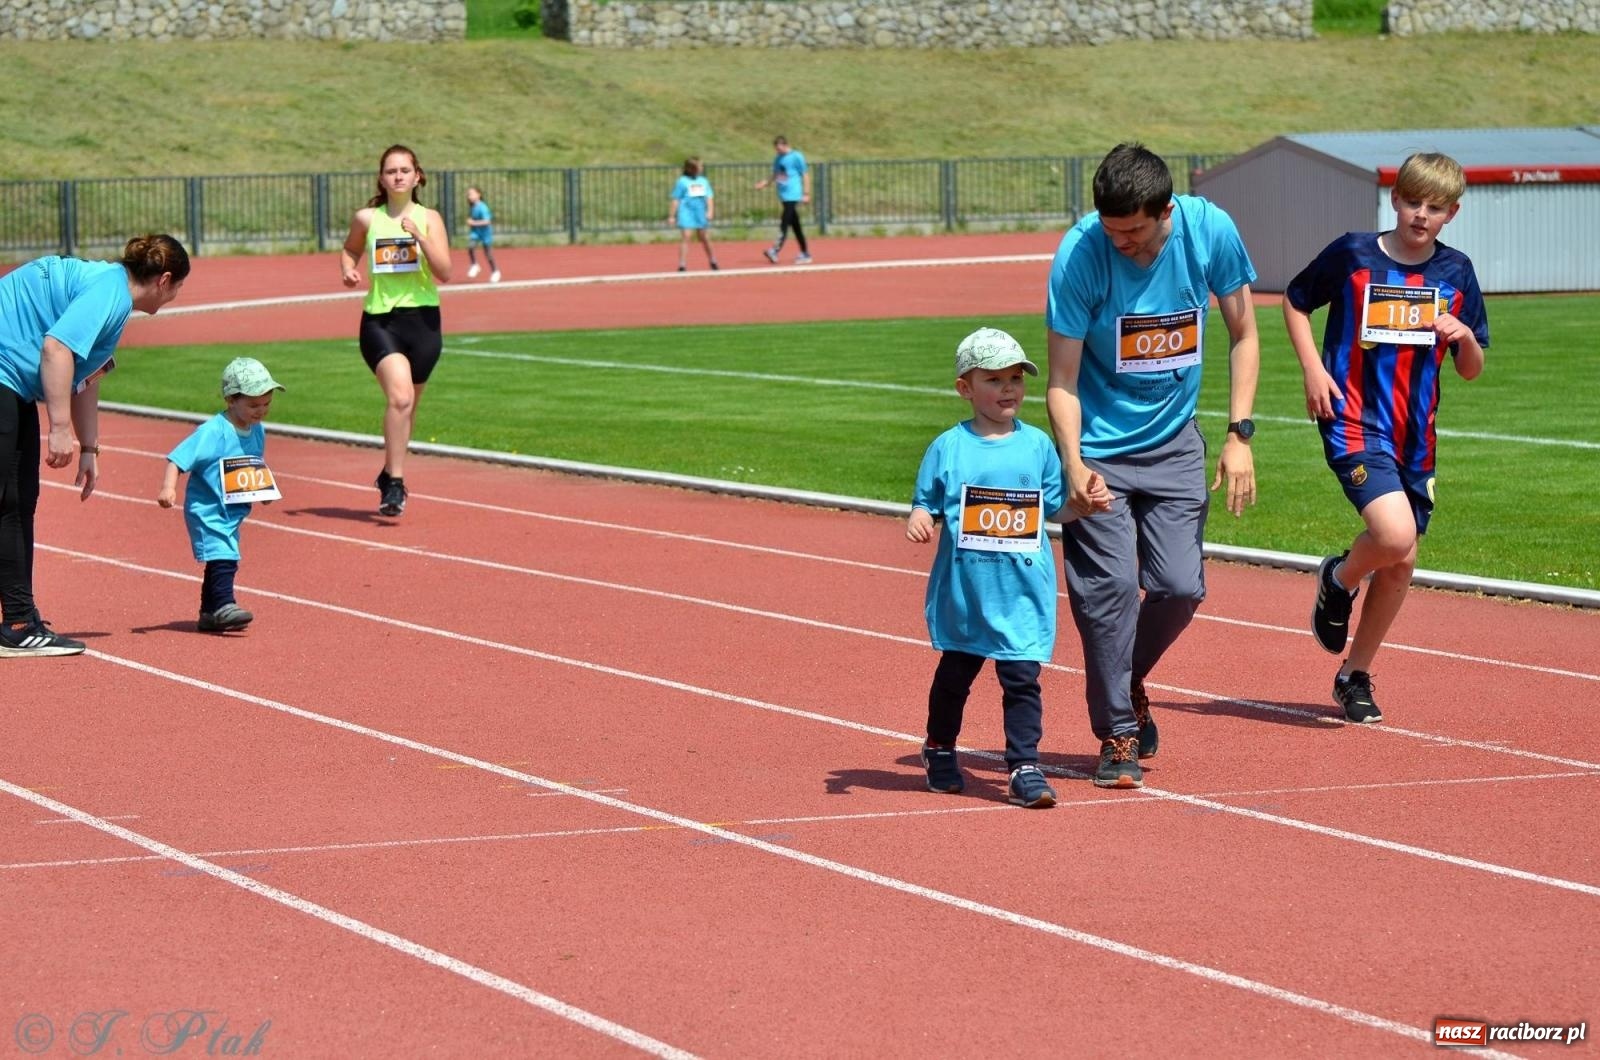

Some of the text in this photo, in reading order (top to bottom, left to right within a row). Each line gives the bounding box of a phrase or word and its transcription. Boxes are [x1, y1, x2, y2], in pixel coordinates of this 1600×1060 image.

[1388, 304, 1420, 326] 118
[1136, 331, 1183, 354] 020
[237, 470, 265, 488] 012
[979, 507, 1026, 532] 008
